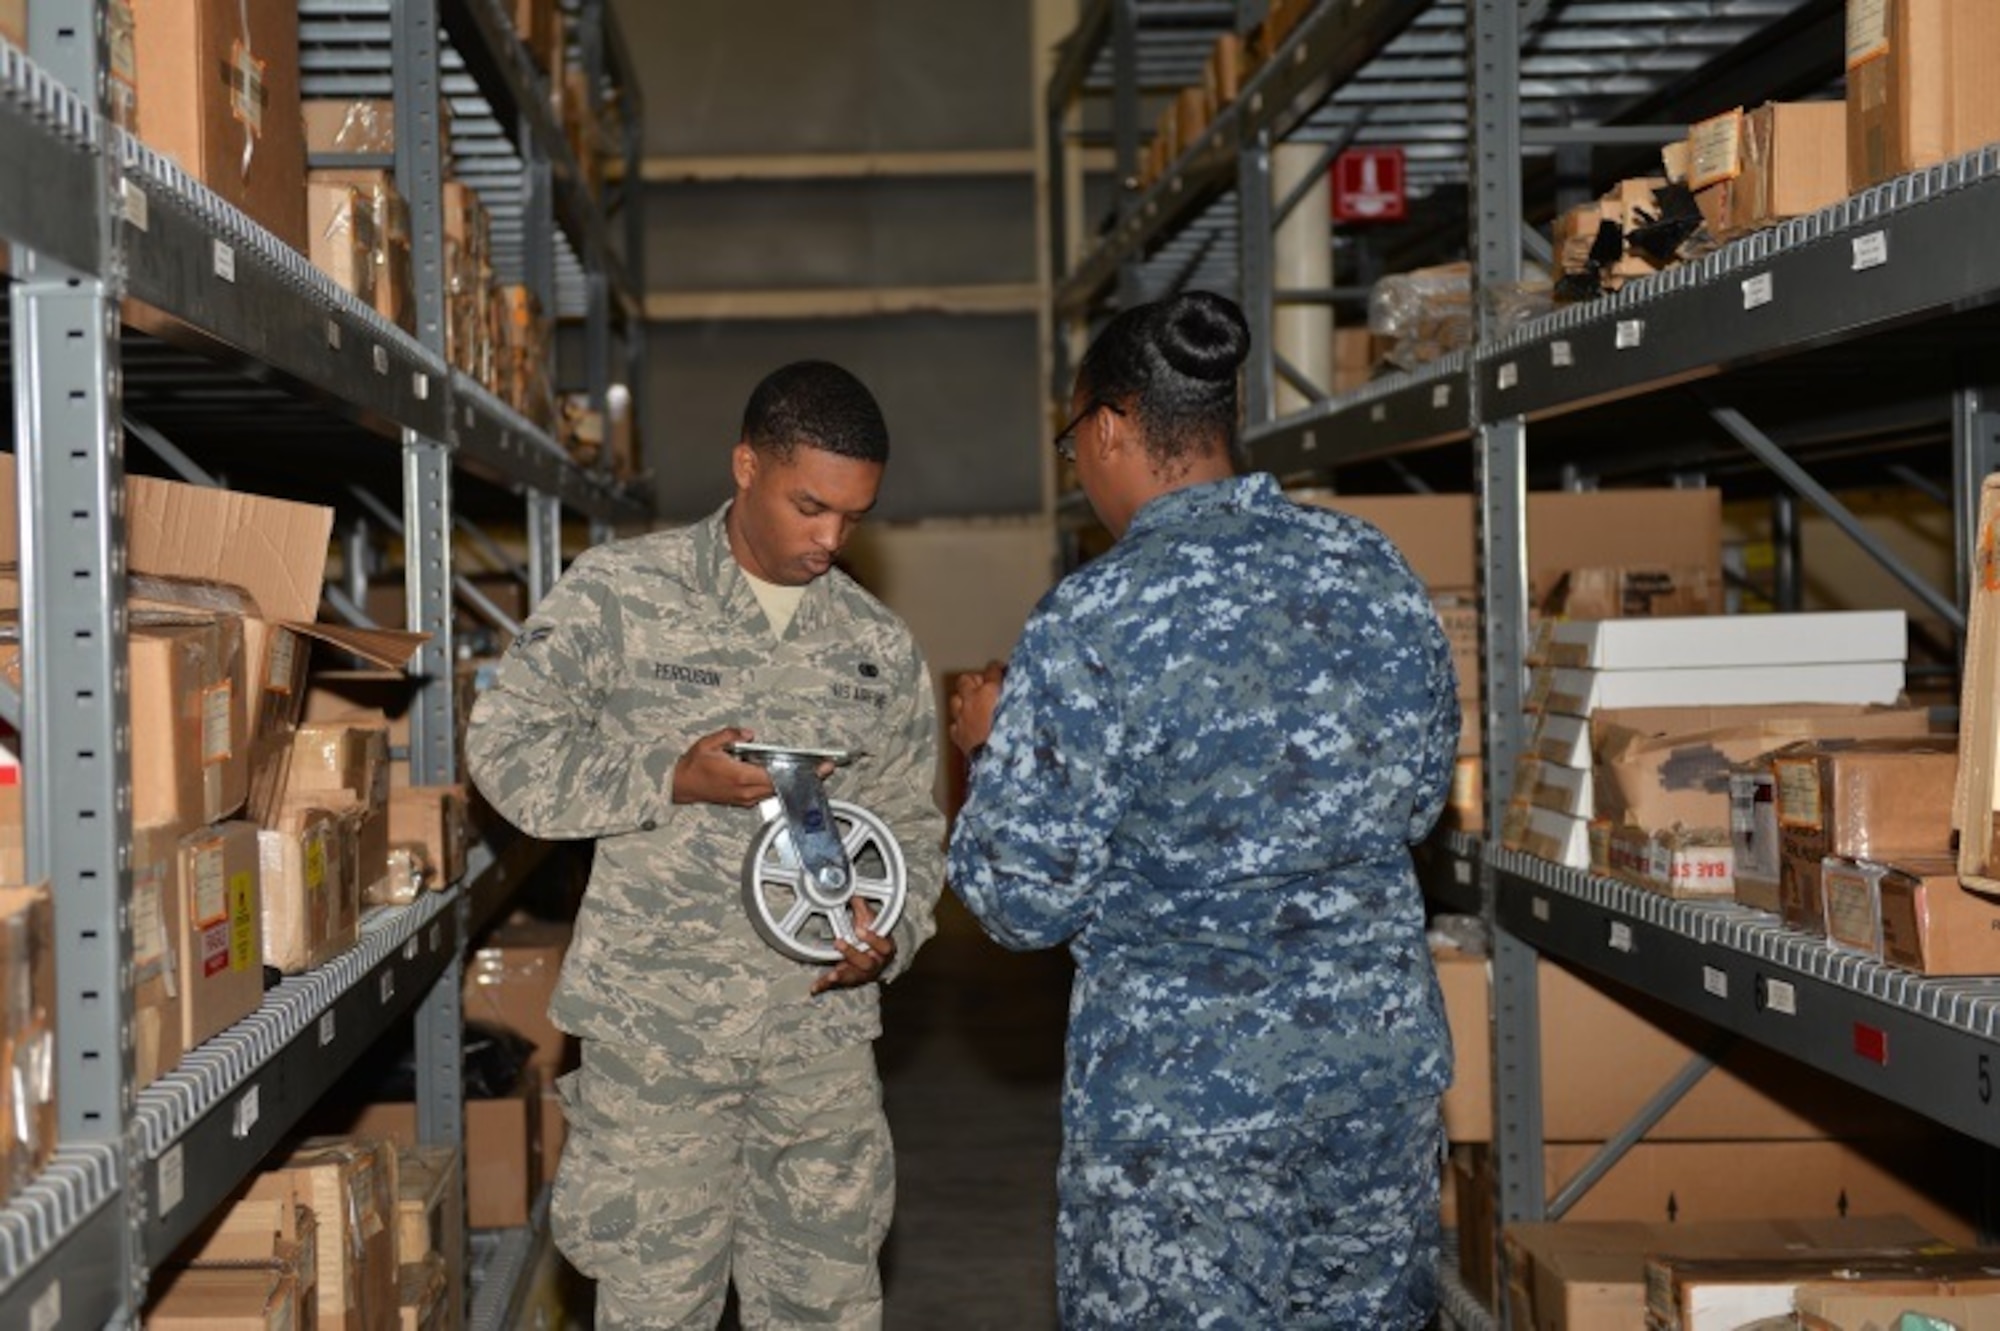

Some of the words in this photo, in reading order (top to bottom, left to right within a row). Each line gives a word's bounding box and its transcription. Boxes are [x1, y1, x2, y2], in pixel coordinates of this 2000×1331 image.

[655, 661, 722, 687] FERGUSON
[1697, 862, 1726, 879] BAE
[1978, 1054, 1992, 1106] 5
